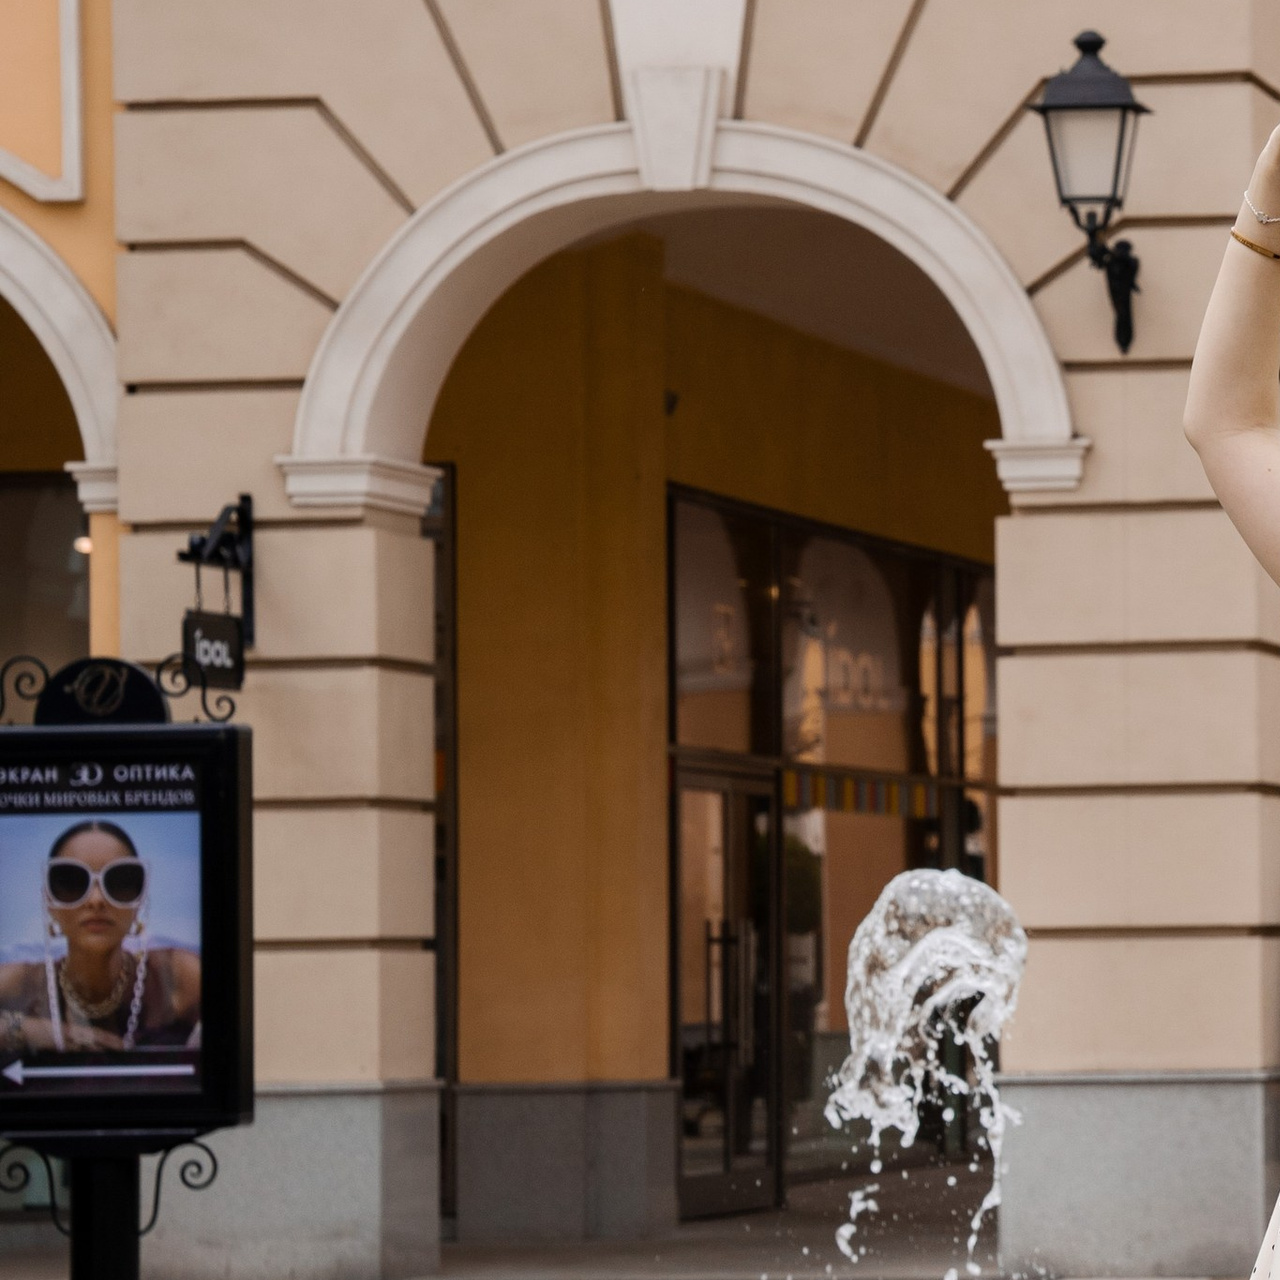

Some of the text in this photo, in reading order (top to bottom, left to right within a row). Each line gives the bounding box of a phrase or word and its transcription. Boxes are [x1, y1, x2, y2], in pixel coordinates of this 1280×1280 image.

[113, 763, 196, 783] ОПТИКА
[43, 790, 122, 807] МИРОВЫХ
[124, 789, 196, 806] БРЕНДОВ
